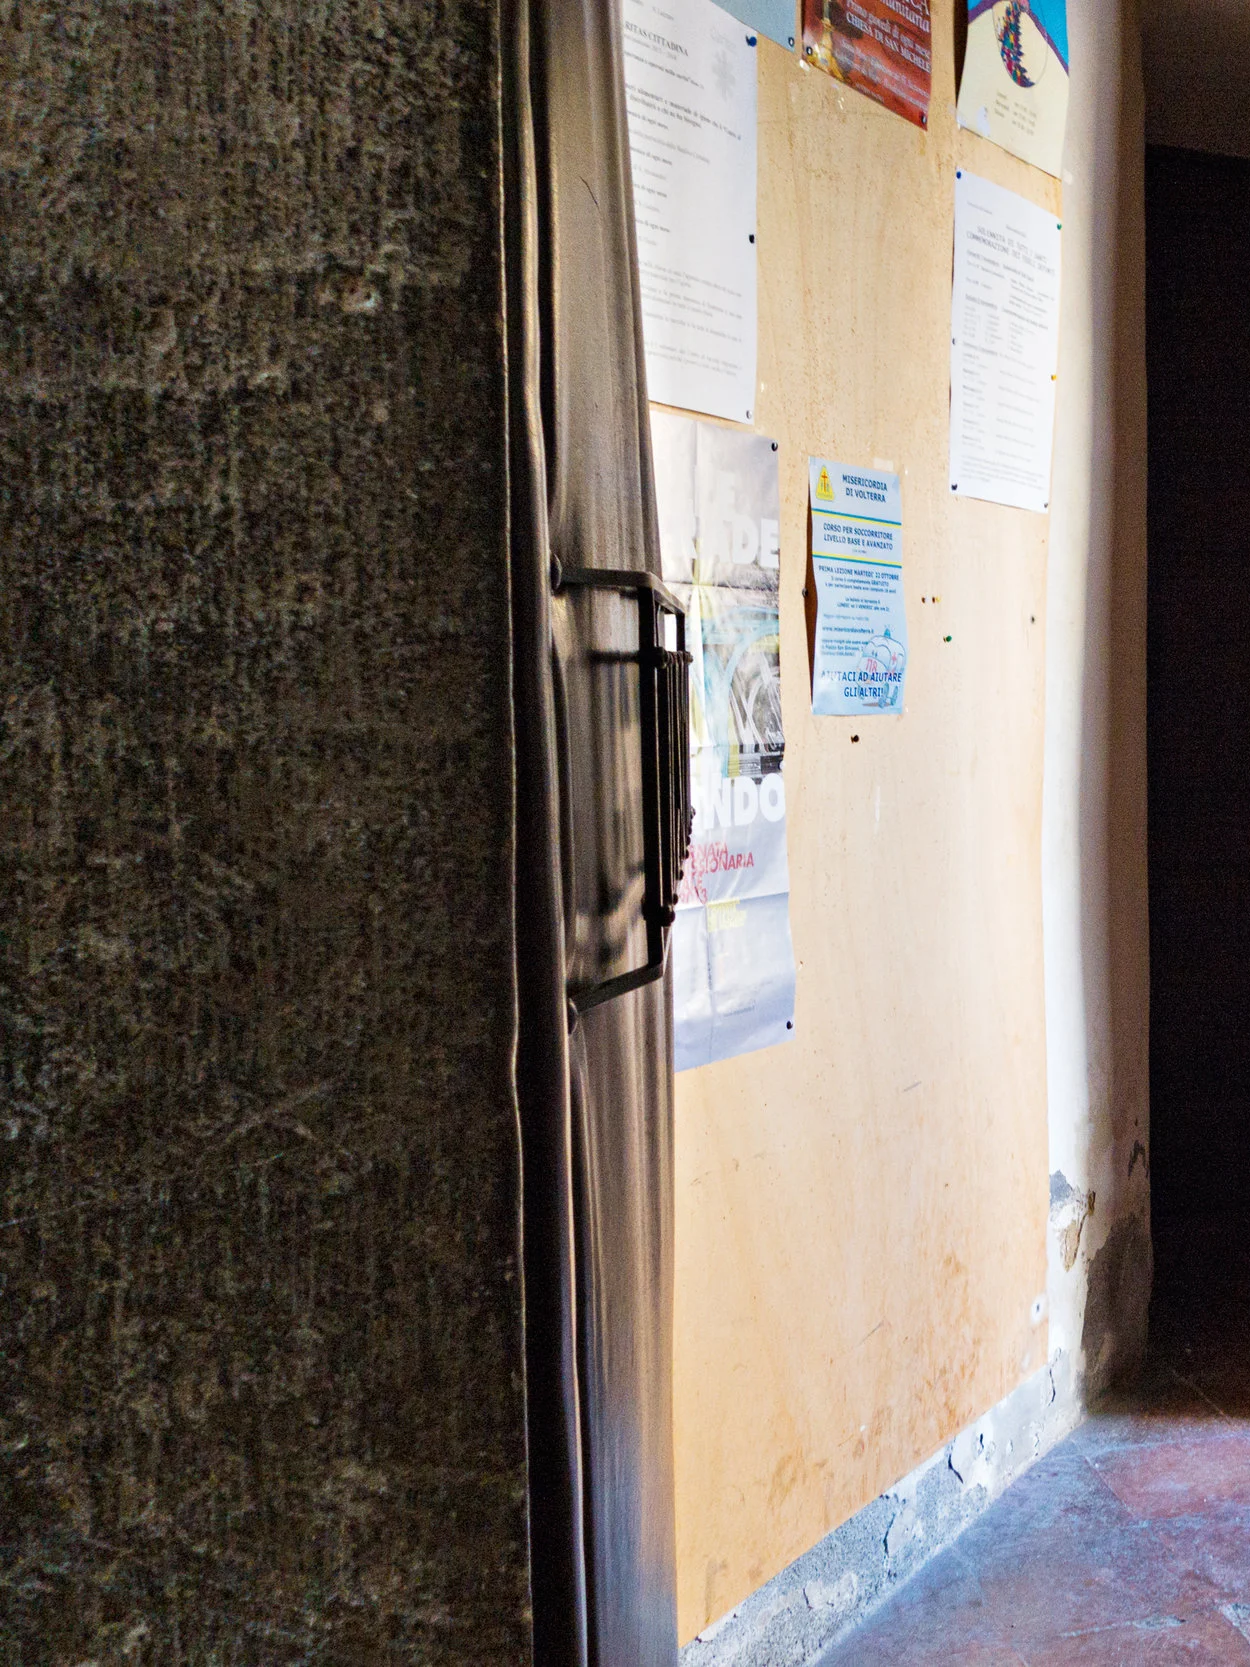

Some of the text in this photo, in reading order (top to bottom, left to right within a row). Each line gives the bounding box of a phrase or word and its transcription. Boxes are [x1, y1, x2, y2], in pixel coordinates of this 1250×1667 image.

[624, 20, 648, 38] RITAS
[648, 29, 689, 57] CITTADINA
[846, 12, 874, 37] CHIESA
[884, 36, 900, 52] SAN
[900, 46, 931, 74] MICHELE
[842, 474, 888, 492] MISERICORDIA
[845, 487, 854, 496] DI
[855, 489, 886, 503] VOLTERRA
[823, 522, 893, 541] CORSO PER SOCCORRITORE
[823, 533, 847, 544] LIVELLO
[847, 536, 861, 546] BASE
[861, 538, 865, 546] E
[866, 539, 893, 551] AVANZATO
[818, 565, 834, 574] PRIMA
[834, 566, 853, 576] LEZIONE
[881, 571, 899, 580] OTTOBRE
[858, 671, 869, 682] AD
[870, 672, 902, 683] AIUTARE
[843, 686, 884, 698] GLI ALTRI!
[703, 773, 786, 830] NDO
